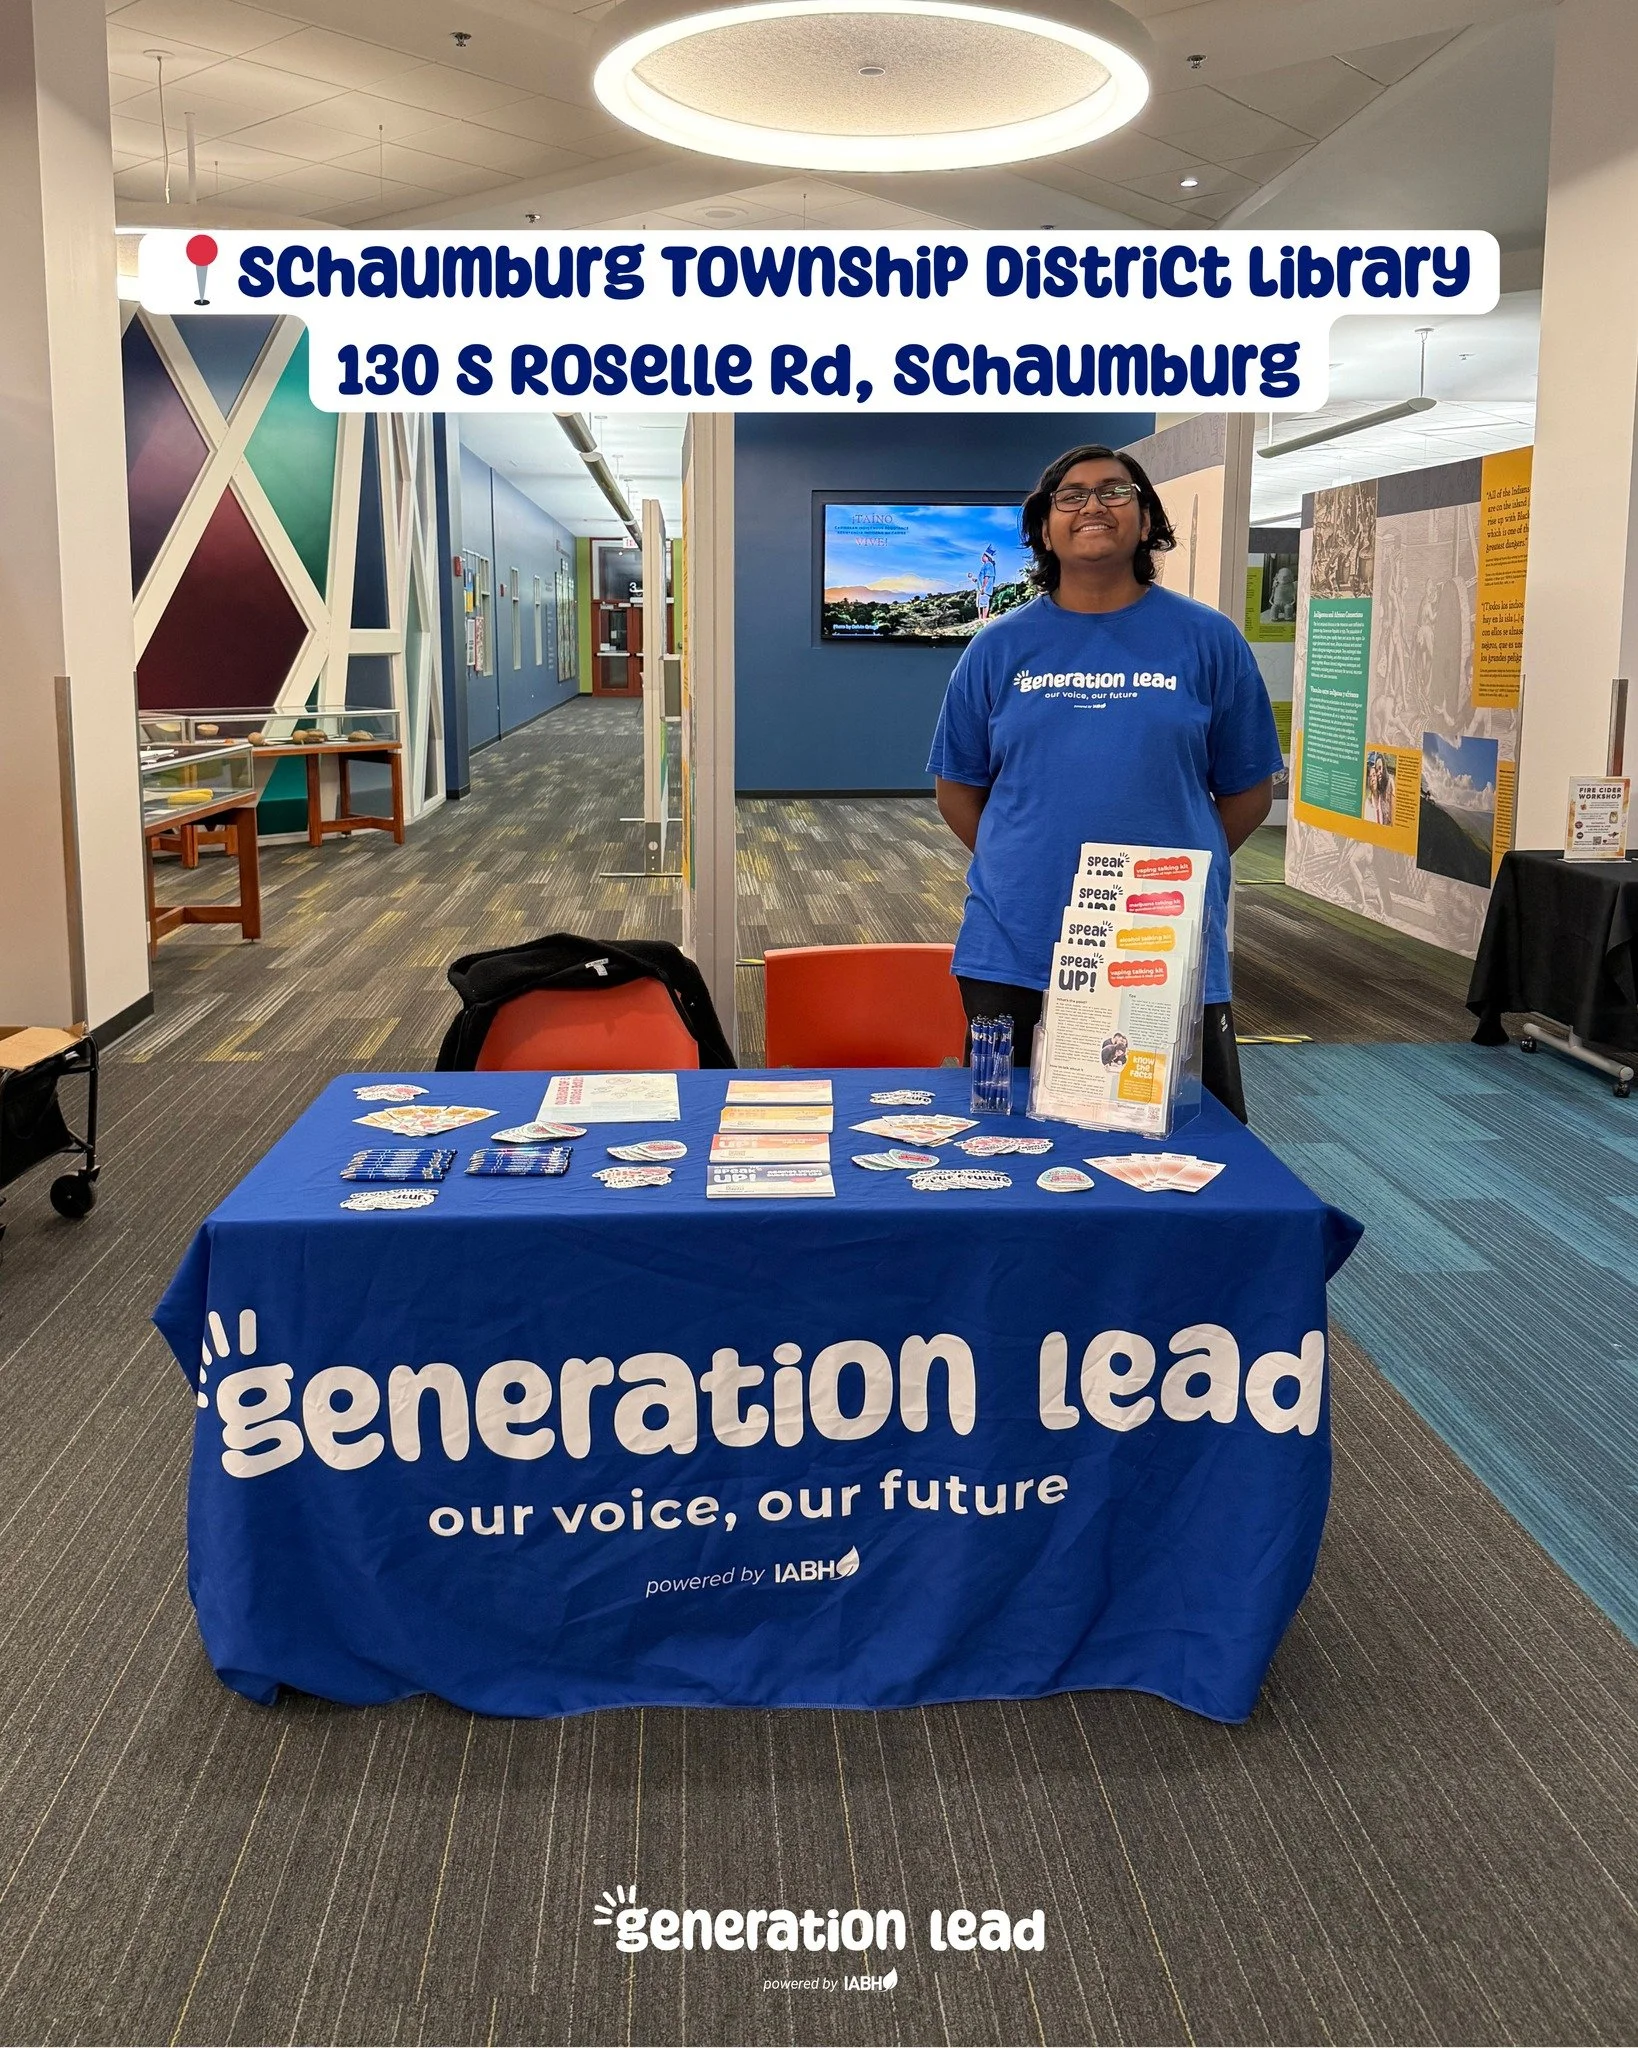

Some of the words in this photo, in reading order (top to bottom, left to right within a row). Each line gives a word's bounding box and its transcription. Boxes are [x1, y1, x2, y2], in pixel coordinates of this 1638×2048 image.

[1497, 490, 1502, 498] of
[1512, 485, 1530, 496] Indians
[1512, 497, 1526, 508] island
[1488, 516, 1496, 526] rise
[1498, 517, 1503, 526] up
[1504, 514, 1516, 524] with
[1487, 528, 1501, 538] which
[1502, 528, 1507, 536] is
[1517, 526, 1522, 536] of
[1486, 543, 1505, 554] greatest
[629, 582, 637, 592] 3
[1483, 614, 1491, 625] hay
[1499, 614, 1504, 622] la
[1504, 613, 1512, 622] isla
[1491, 626, 1502, 636] ellos
[1499, 642, 1507, 650] que
[1488, 652, 1506, 664] grandes
[1508, 652, 1522, 664] peligr
[1020, 672, 1125, 692] generation
[1133, 672, 1177, 691] lead
[1062, 690, 1089, 700] voice,
[1110, 691, 1138, 699] future
[1087, 856, 1124, 868] speak
[1079, 888, 1118, 900] speak
[1069, 924, 1108, 937] speak
[1060, 956, 1098, 969] speak
[1058, 969, 1096, 992] UP!
[217, 1332, 976, 1478] generation
[1039, 1323, 1325, 1436] lead
[429, 1505, 534, 1537] our
[553, 1488, 737, 1533] voice,
[758, 1483, 861, 1521] our
[879, 1469, 1068, 1516] future
[646, 1567, 735, 1598] powered
[740, 1567, 766, 1585] by
[774, 1560, 835, 1583] IABH
